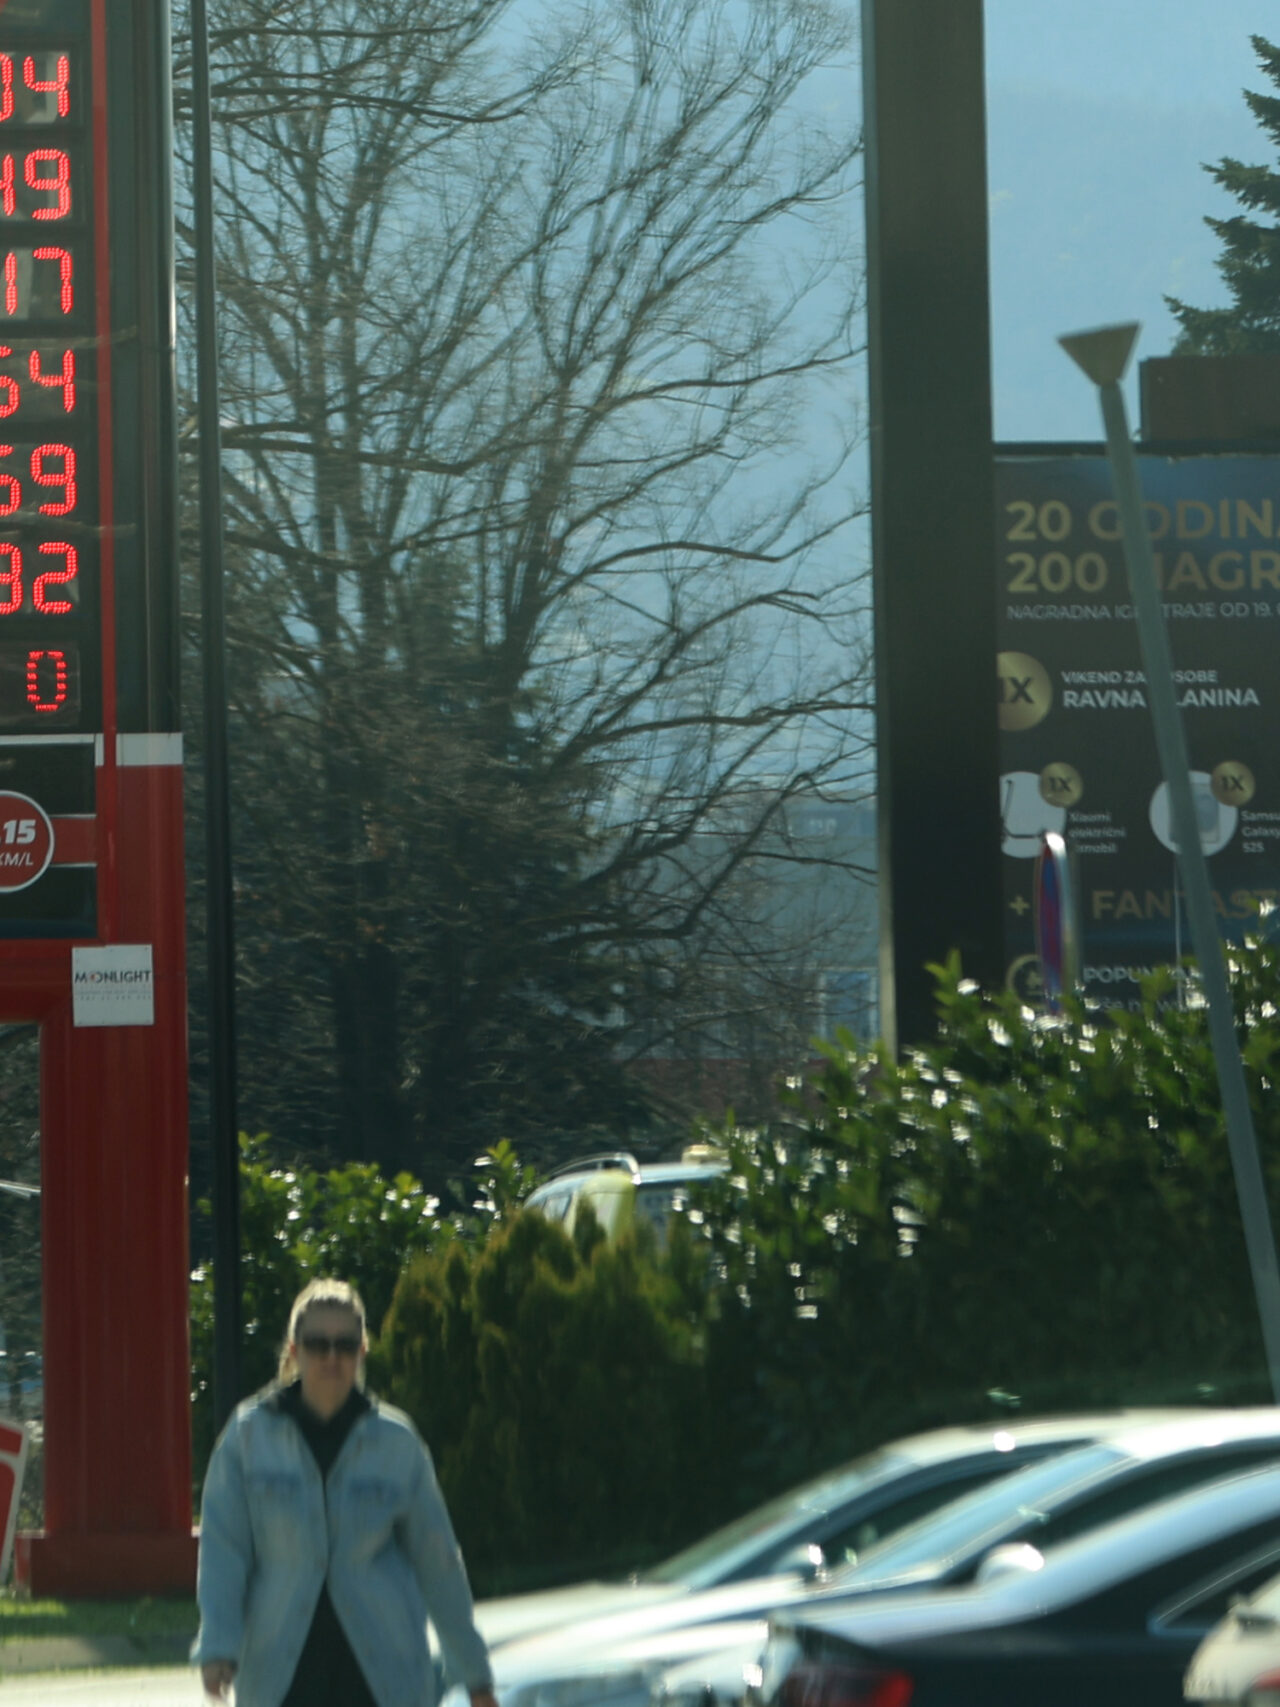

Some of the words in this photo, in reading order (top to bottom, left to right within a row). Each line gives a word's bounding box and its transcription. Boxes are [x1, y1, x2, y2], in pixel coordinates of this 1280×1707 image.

[1005, 500, 1073, 542] 20
[1005, 551, 1109, 594] 200
[1007, 604, 1111, 621] NAGRADNA
[1220, 602, 1250, 617] OD
[27, 650, 68, 713] 0
[1061, 671, 1122, 684] VIKEND
[1124, 671, 1147, 683] ZA
[1063, 689, 1147, 709] RAVNA
[75, 970, 152, 985] MOONLIGHT
